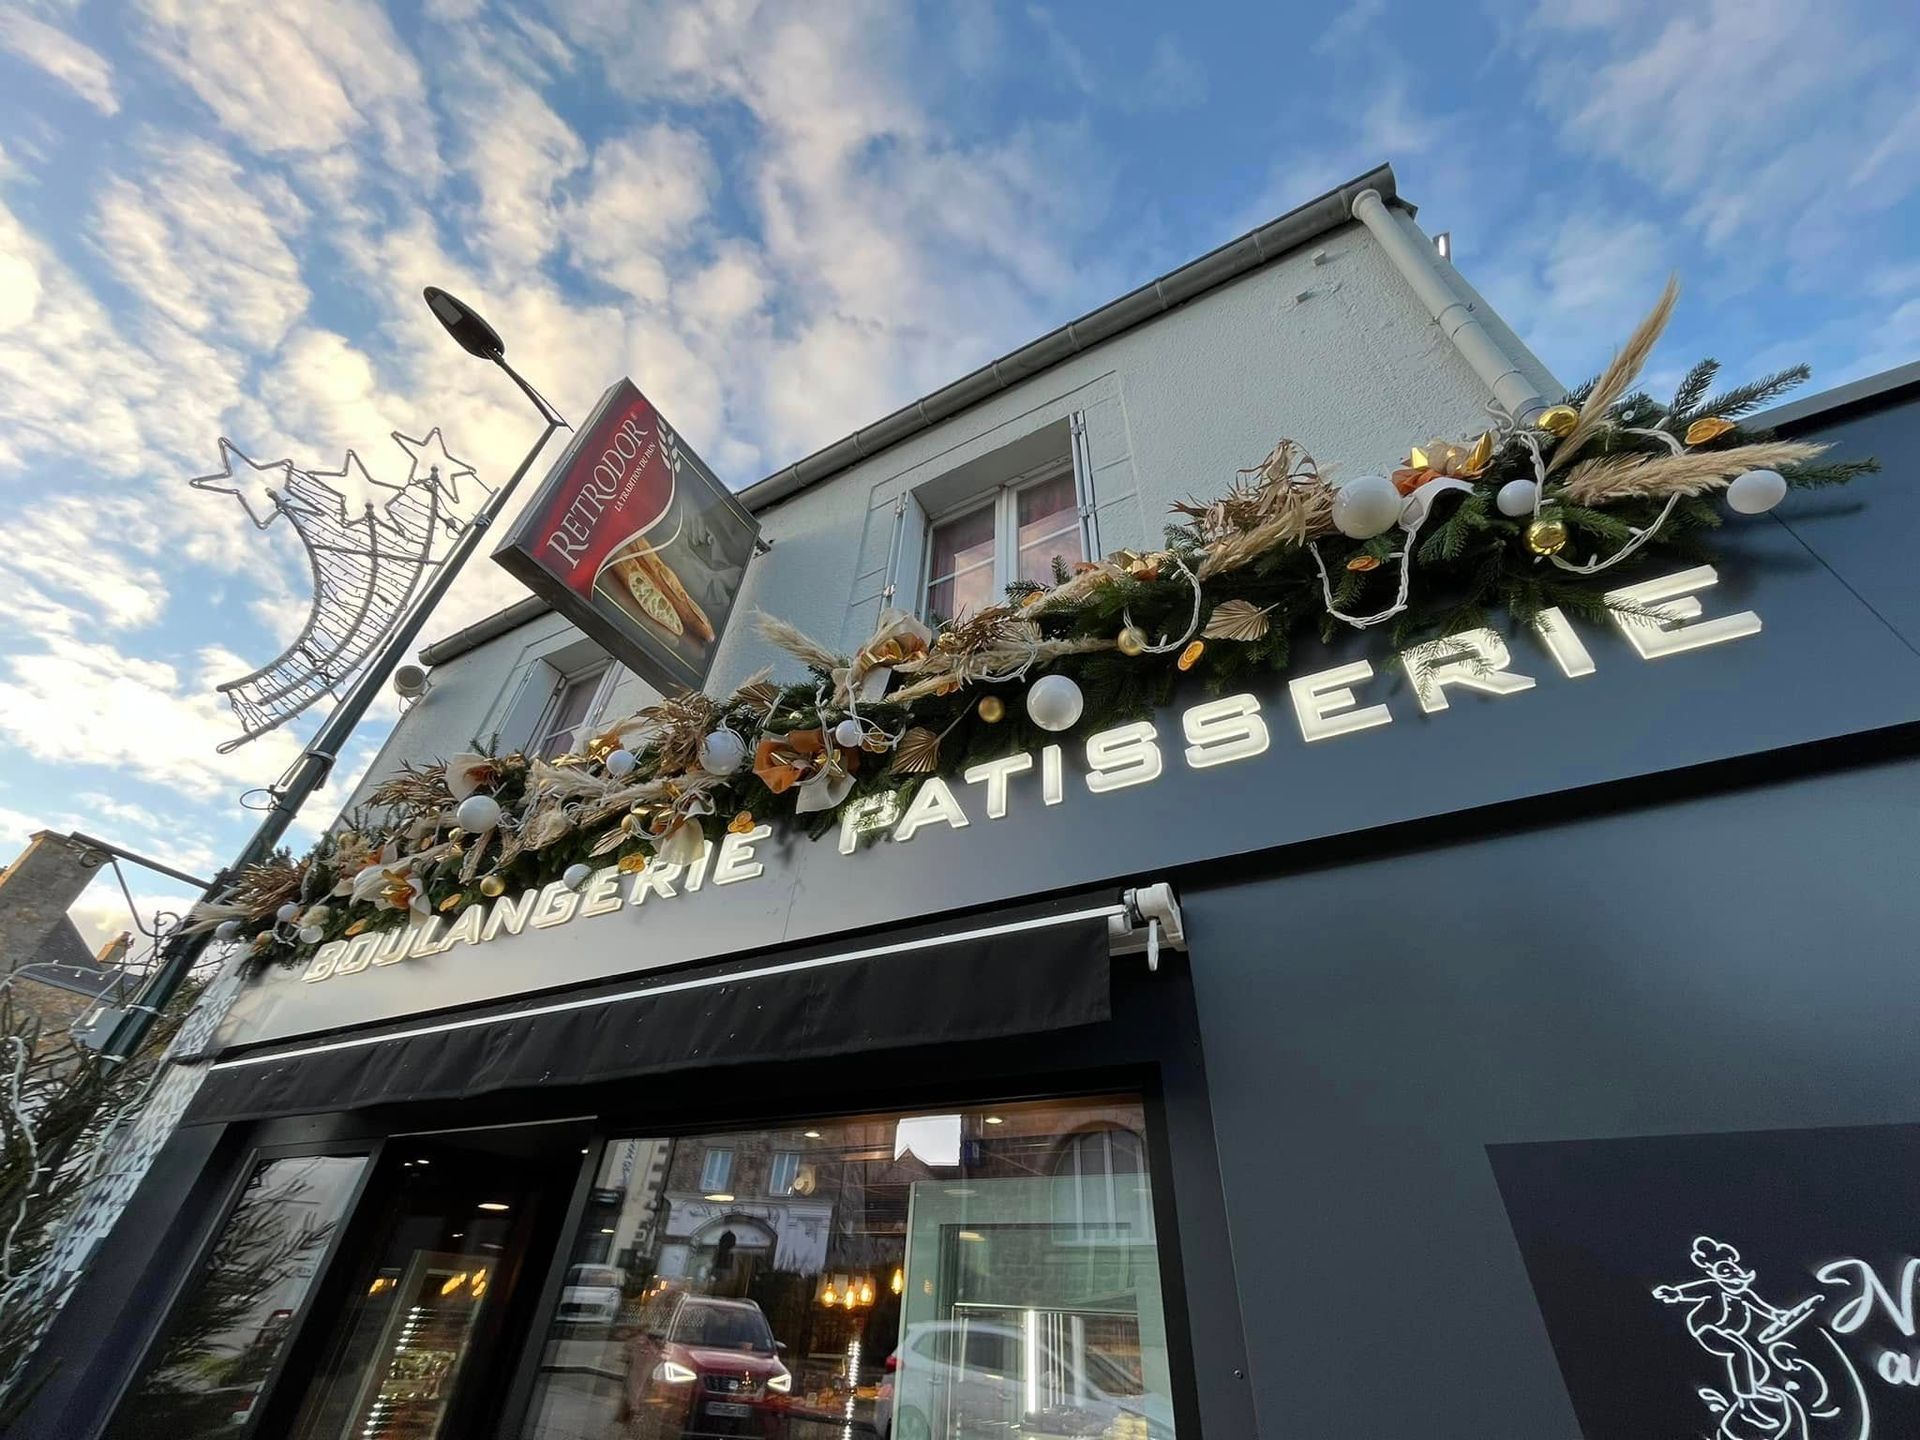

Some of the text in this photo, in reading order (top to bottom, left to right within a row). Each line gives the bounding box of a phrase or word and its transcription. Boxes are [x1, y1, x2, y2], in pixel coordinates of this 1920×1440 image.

[546, 419, 649, 570] RETRODOR
[620, 465, 643, 501] TRADITION
[301, 564, 1763, 984] BOULANGERIE PATISSERIE
